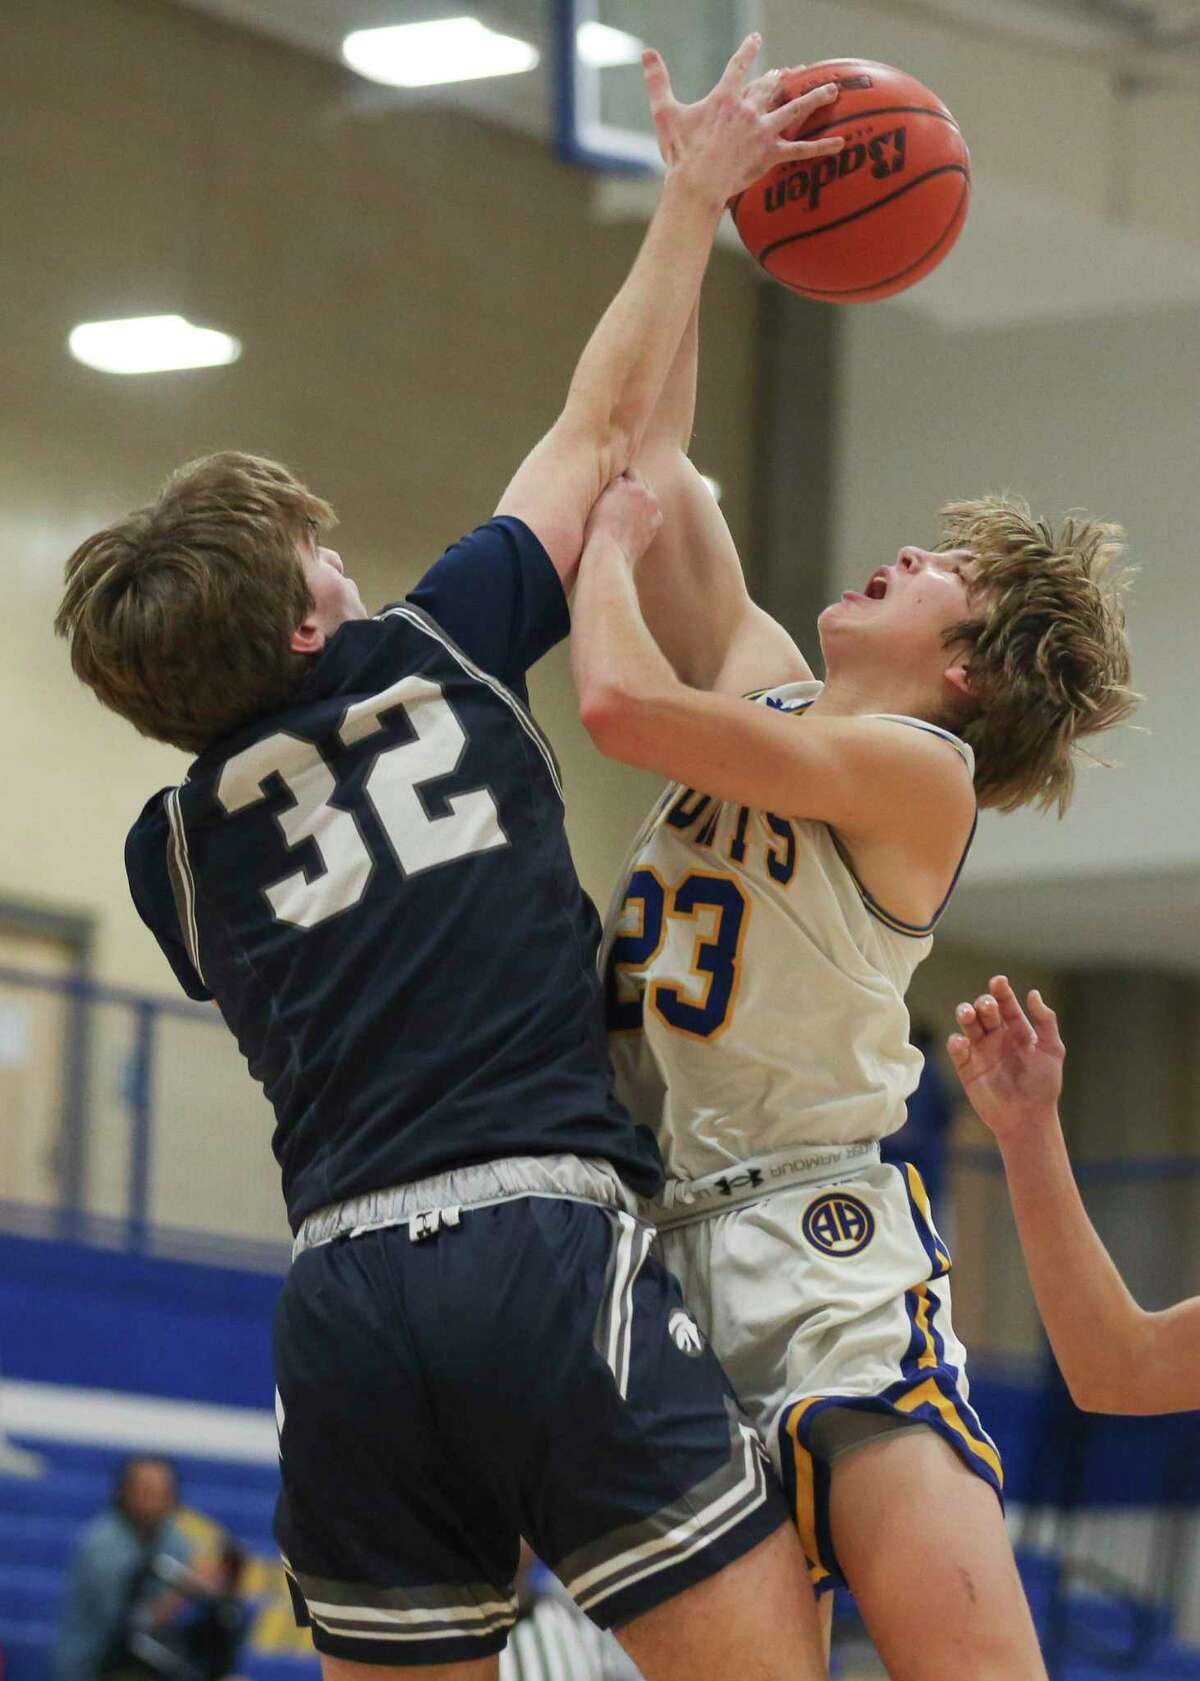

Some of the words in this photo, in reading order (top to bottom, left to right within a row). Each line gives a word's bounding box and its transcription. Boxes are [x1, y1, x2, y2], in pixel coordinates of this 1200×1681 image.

[764, 126, 907, 214] Baden
[216, 671, 512, 931] 32
[606, 863, 751, 1043] 23
[769, 1151, 843, 1178] ARMOUR
